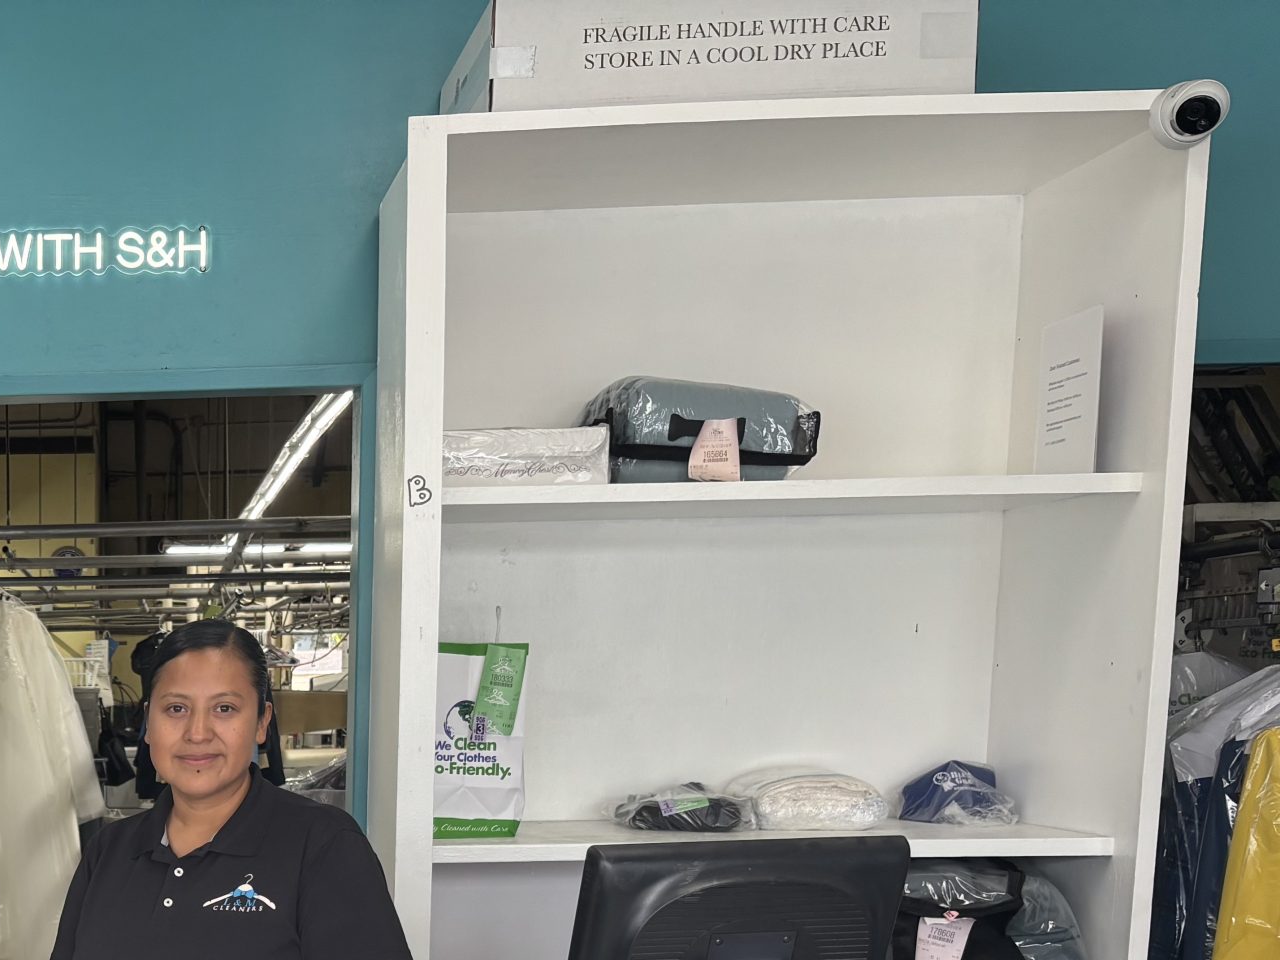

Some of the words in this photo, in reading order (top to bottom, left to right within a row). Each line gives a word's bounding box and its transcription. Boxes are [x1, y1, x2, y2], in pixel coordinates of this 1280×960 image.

[583, 24, 671, 44] FRAGILE
[677, 20, 764, 39] HANDLE
[770, 17, 828, 35] WITH
[833, 15, 890, 32] CARE
[584, 51, 654, 70] STORE
[659, 50, 682, 66] IN
[686, 49, 701, 65] A
[706, 46, 769, 64] COOL
[773, 44, 817, 61] DRY
[821, 41, 887, 59] PLACE
[115, 230, 207, 269] S&H
[435, 740, 451, 750] We
[454, 737, 497, 751] Clean
[457, 753, 497, 763] Clothes
[434, 762, 511, 780] o-Friendly.
[441, 823, 471, 832] Cleaned
[490, 824, 509, 832] Care
